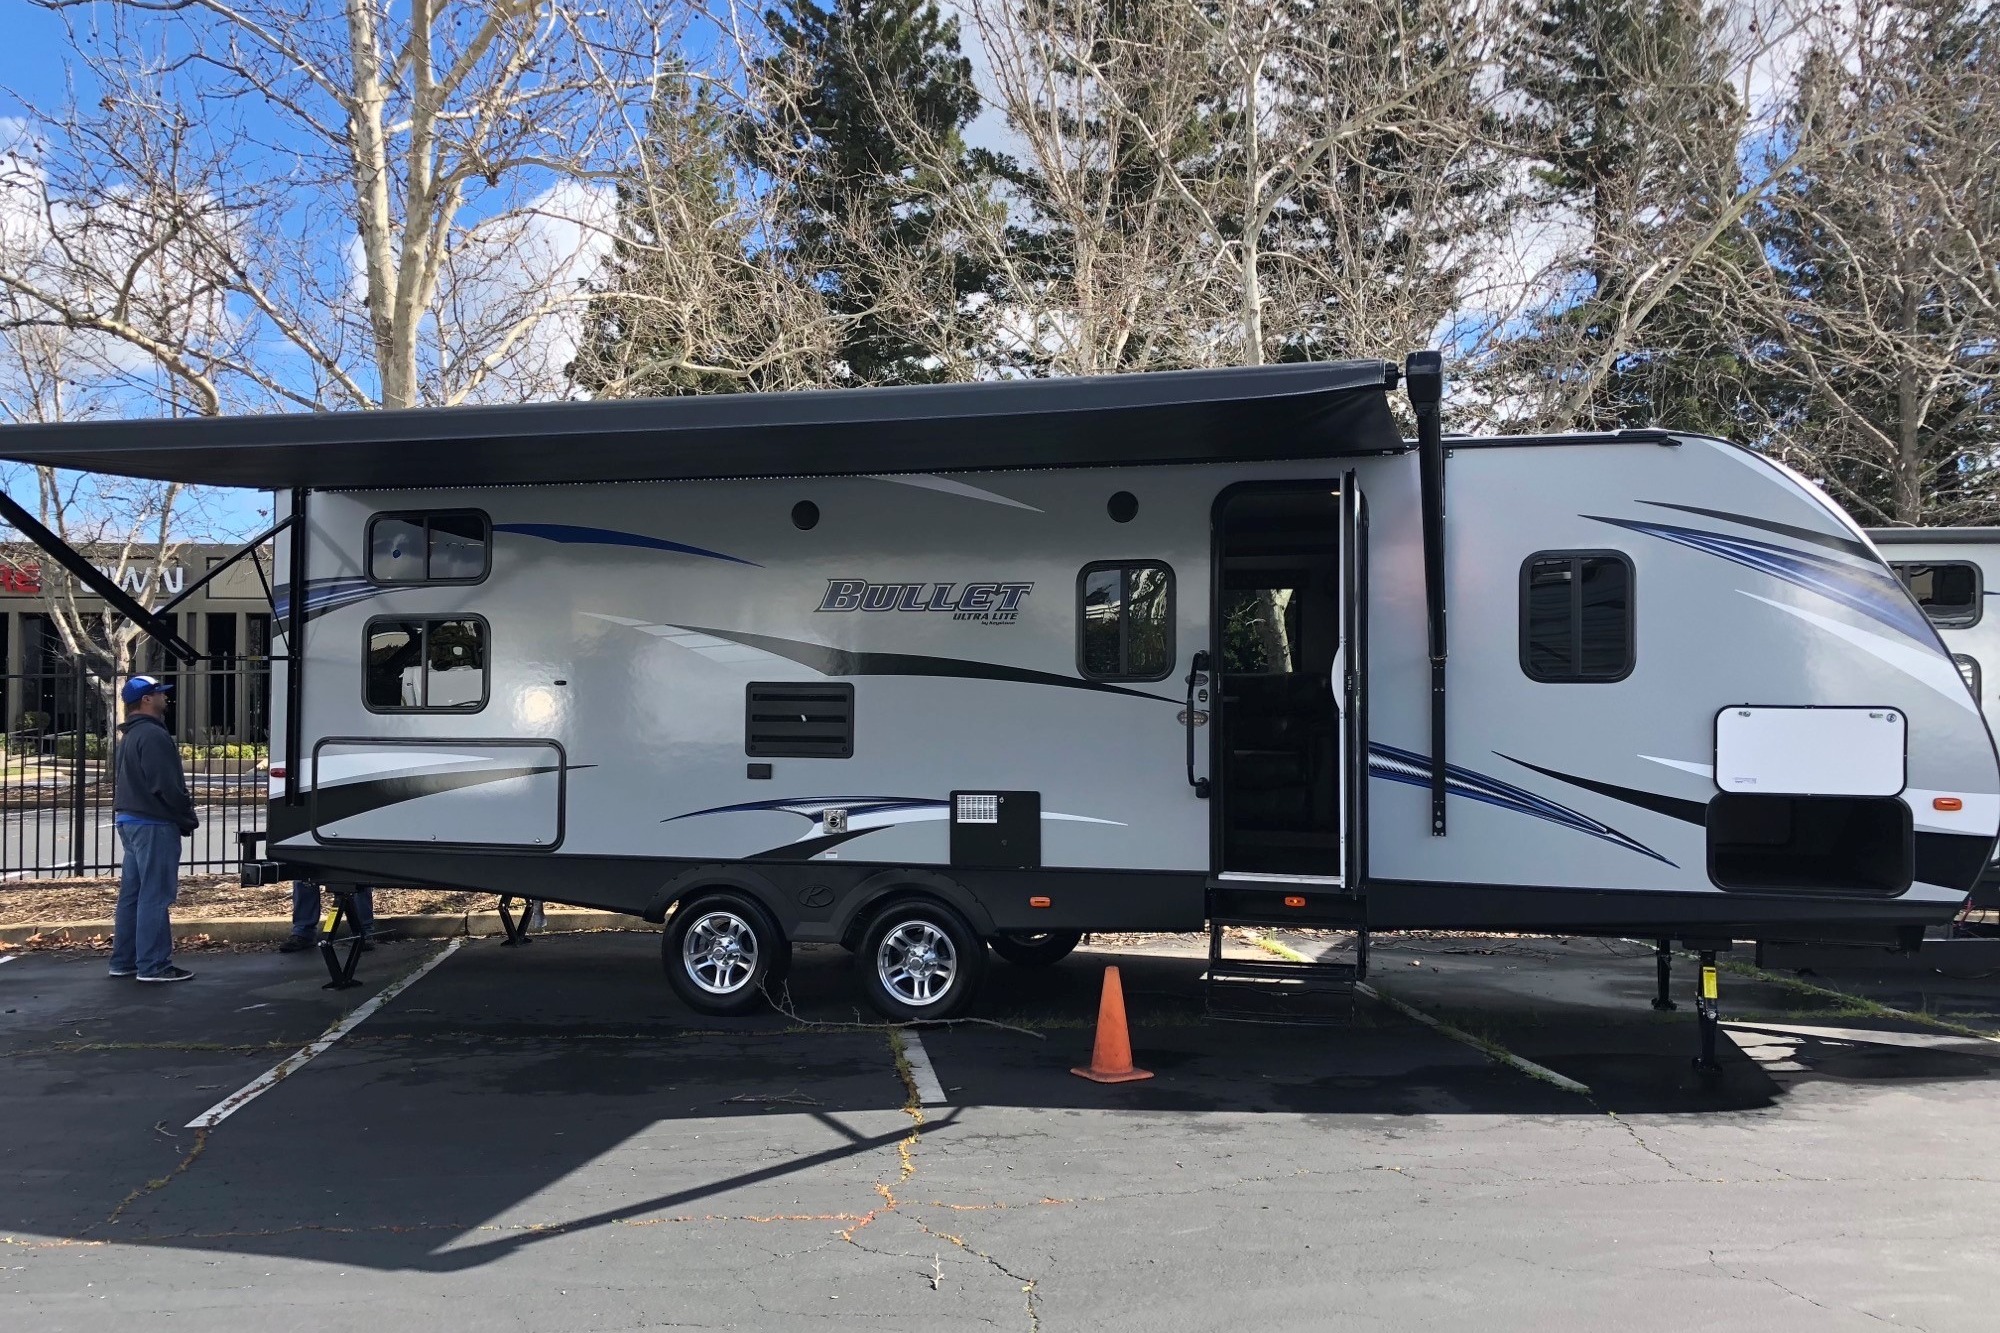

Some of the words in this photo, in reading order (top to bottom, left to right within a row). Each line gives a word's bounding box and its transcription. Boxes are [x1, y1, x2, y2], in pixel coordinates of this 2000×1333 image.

[813, 578, 1035, 612] BULLET
[953, 612, 989, 620] ULTRA
[992, 612, 1018, 620] LITE
